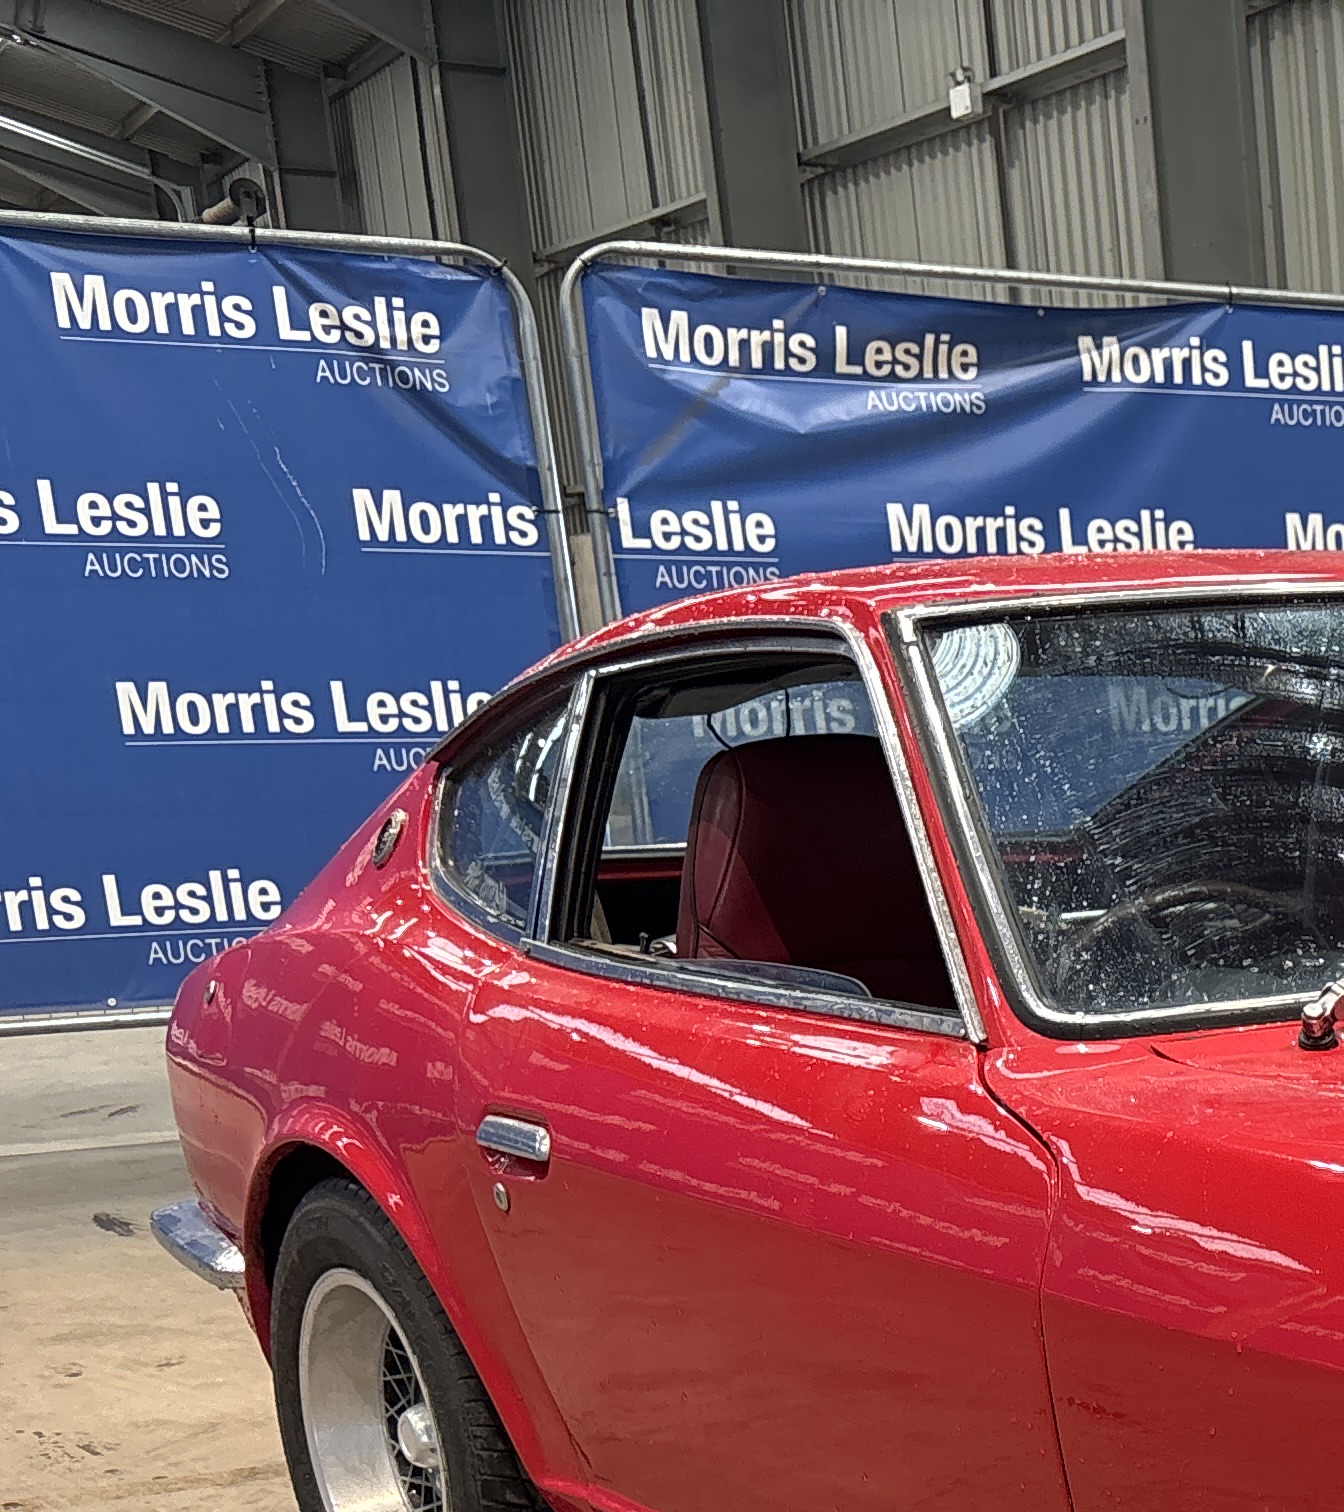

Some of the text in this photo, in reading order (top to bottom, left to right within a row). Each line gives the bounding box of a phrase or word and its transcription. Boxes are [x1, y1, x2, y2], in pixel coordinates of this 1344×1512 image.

[49, 271, 441, 354] Morris Leslie
[640, 306, 978, 381] Morris Leslie
[1077, 335, 1230, 387] Morris
[316, 358, 450, 393] AUCTIONS
[866, 389, 986, 415] AUCTIONS
[36, 479, 222, 538] Leslie
[352, 488, 539, 547] Morris
[615, 496, 776, 553] Leslie
[885, 502, 1195, 558] Morris Leslie
[84, 552, 230, 579] AUCTIONS
[655, 564, 780, 589] AUCTIONS
[115, 680, 315, 735] Morris
[0, 868, 282, 931] ris Leslie
